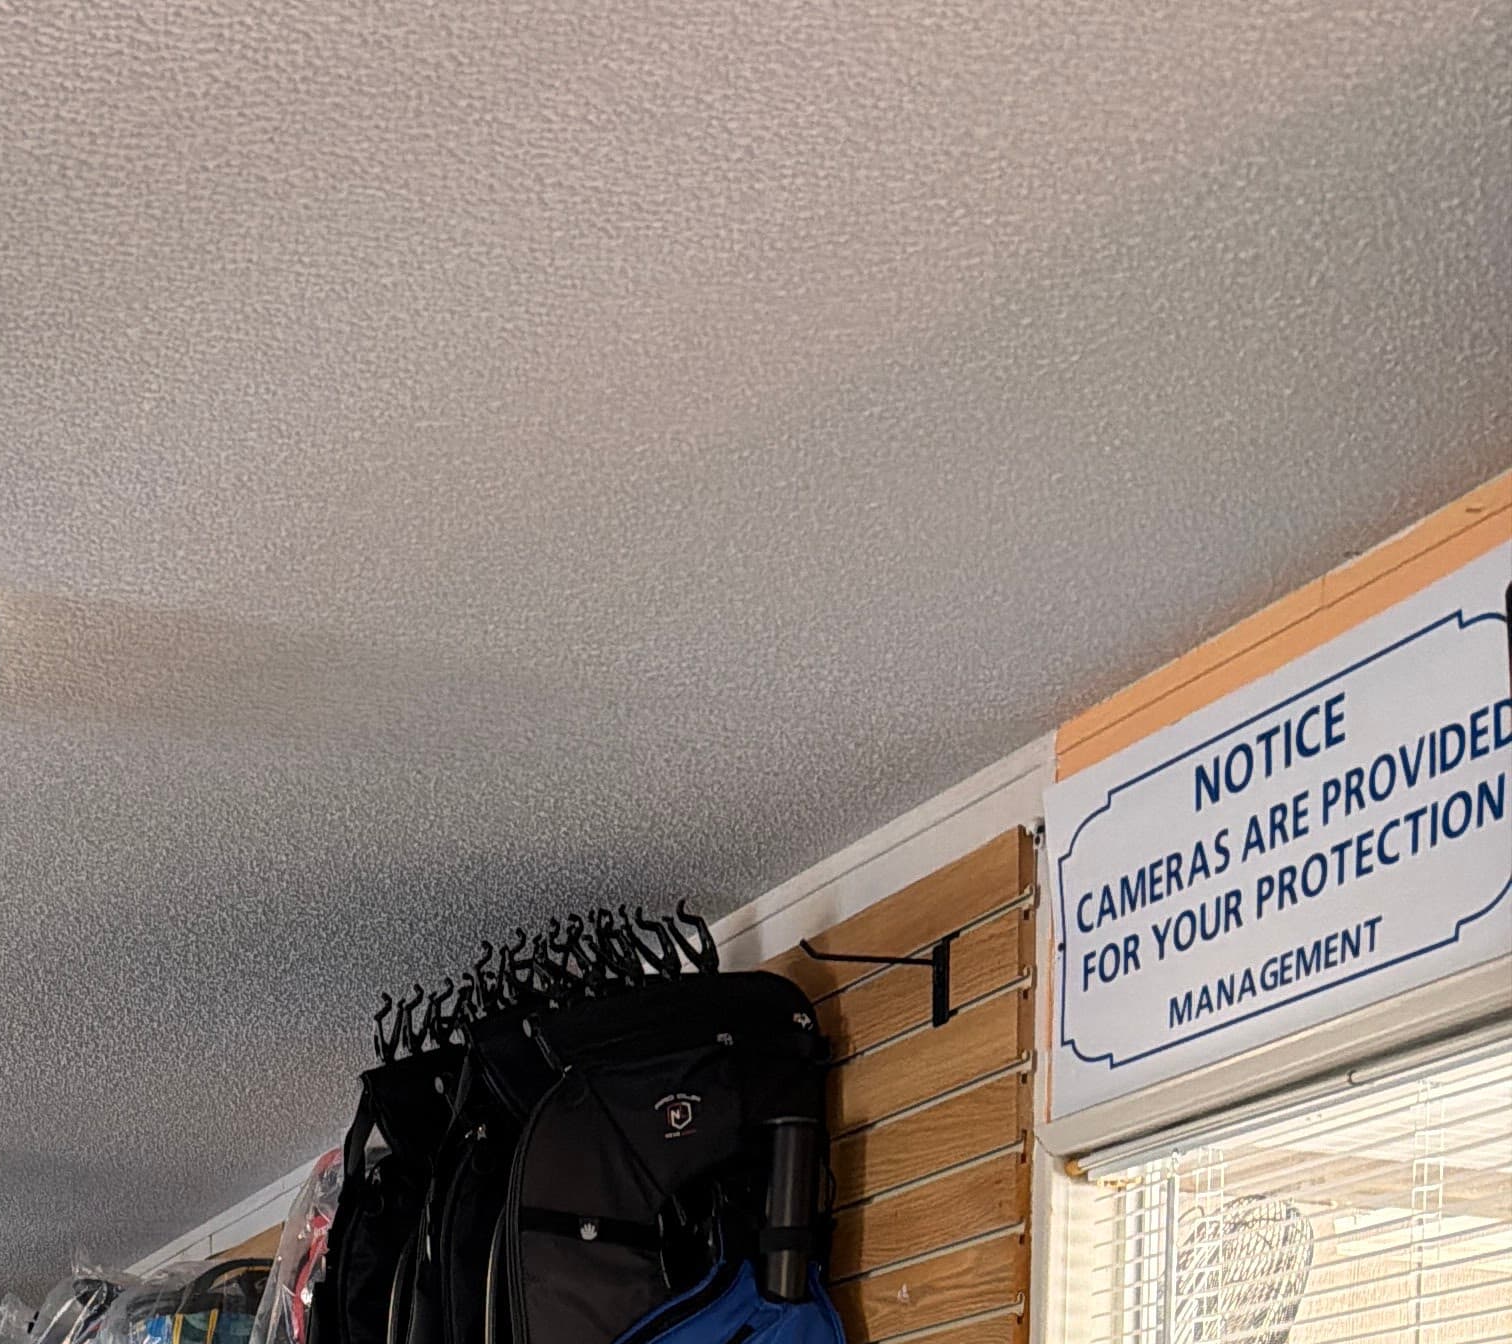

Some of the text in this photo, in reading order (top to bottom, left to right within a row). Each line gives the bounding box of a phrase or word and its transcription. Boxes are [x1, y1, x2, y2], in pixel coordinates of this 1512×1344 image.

[1076, 698, 1512, 933] CAMERAS ARE PROVIDED
[1195, 693, 1345, 811] NOTICE
[1082, 772, 1506, 992] FOR YOUR PROTECTION
[1169, 916, 1382, 1029] MANAGEMENT
